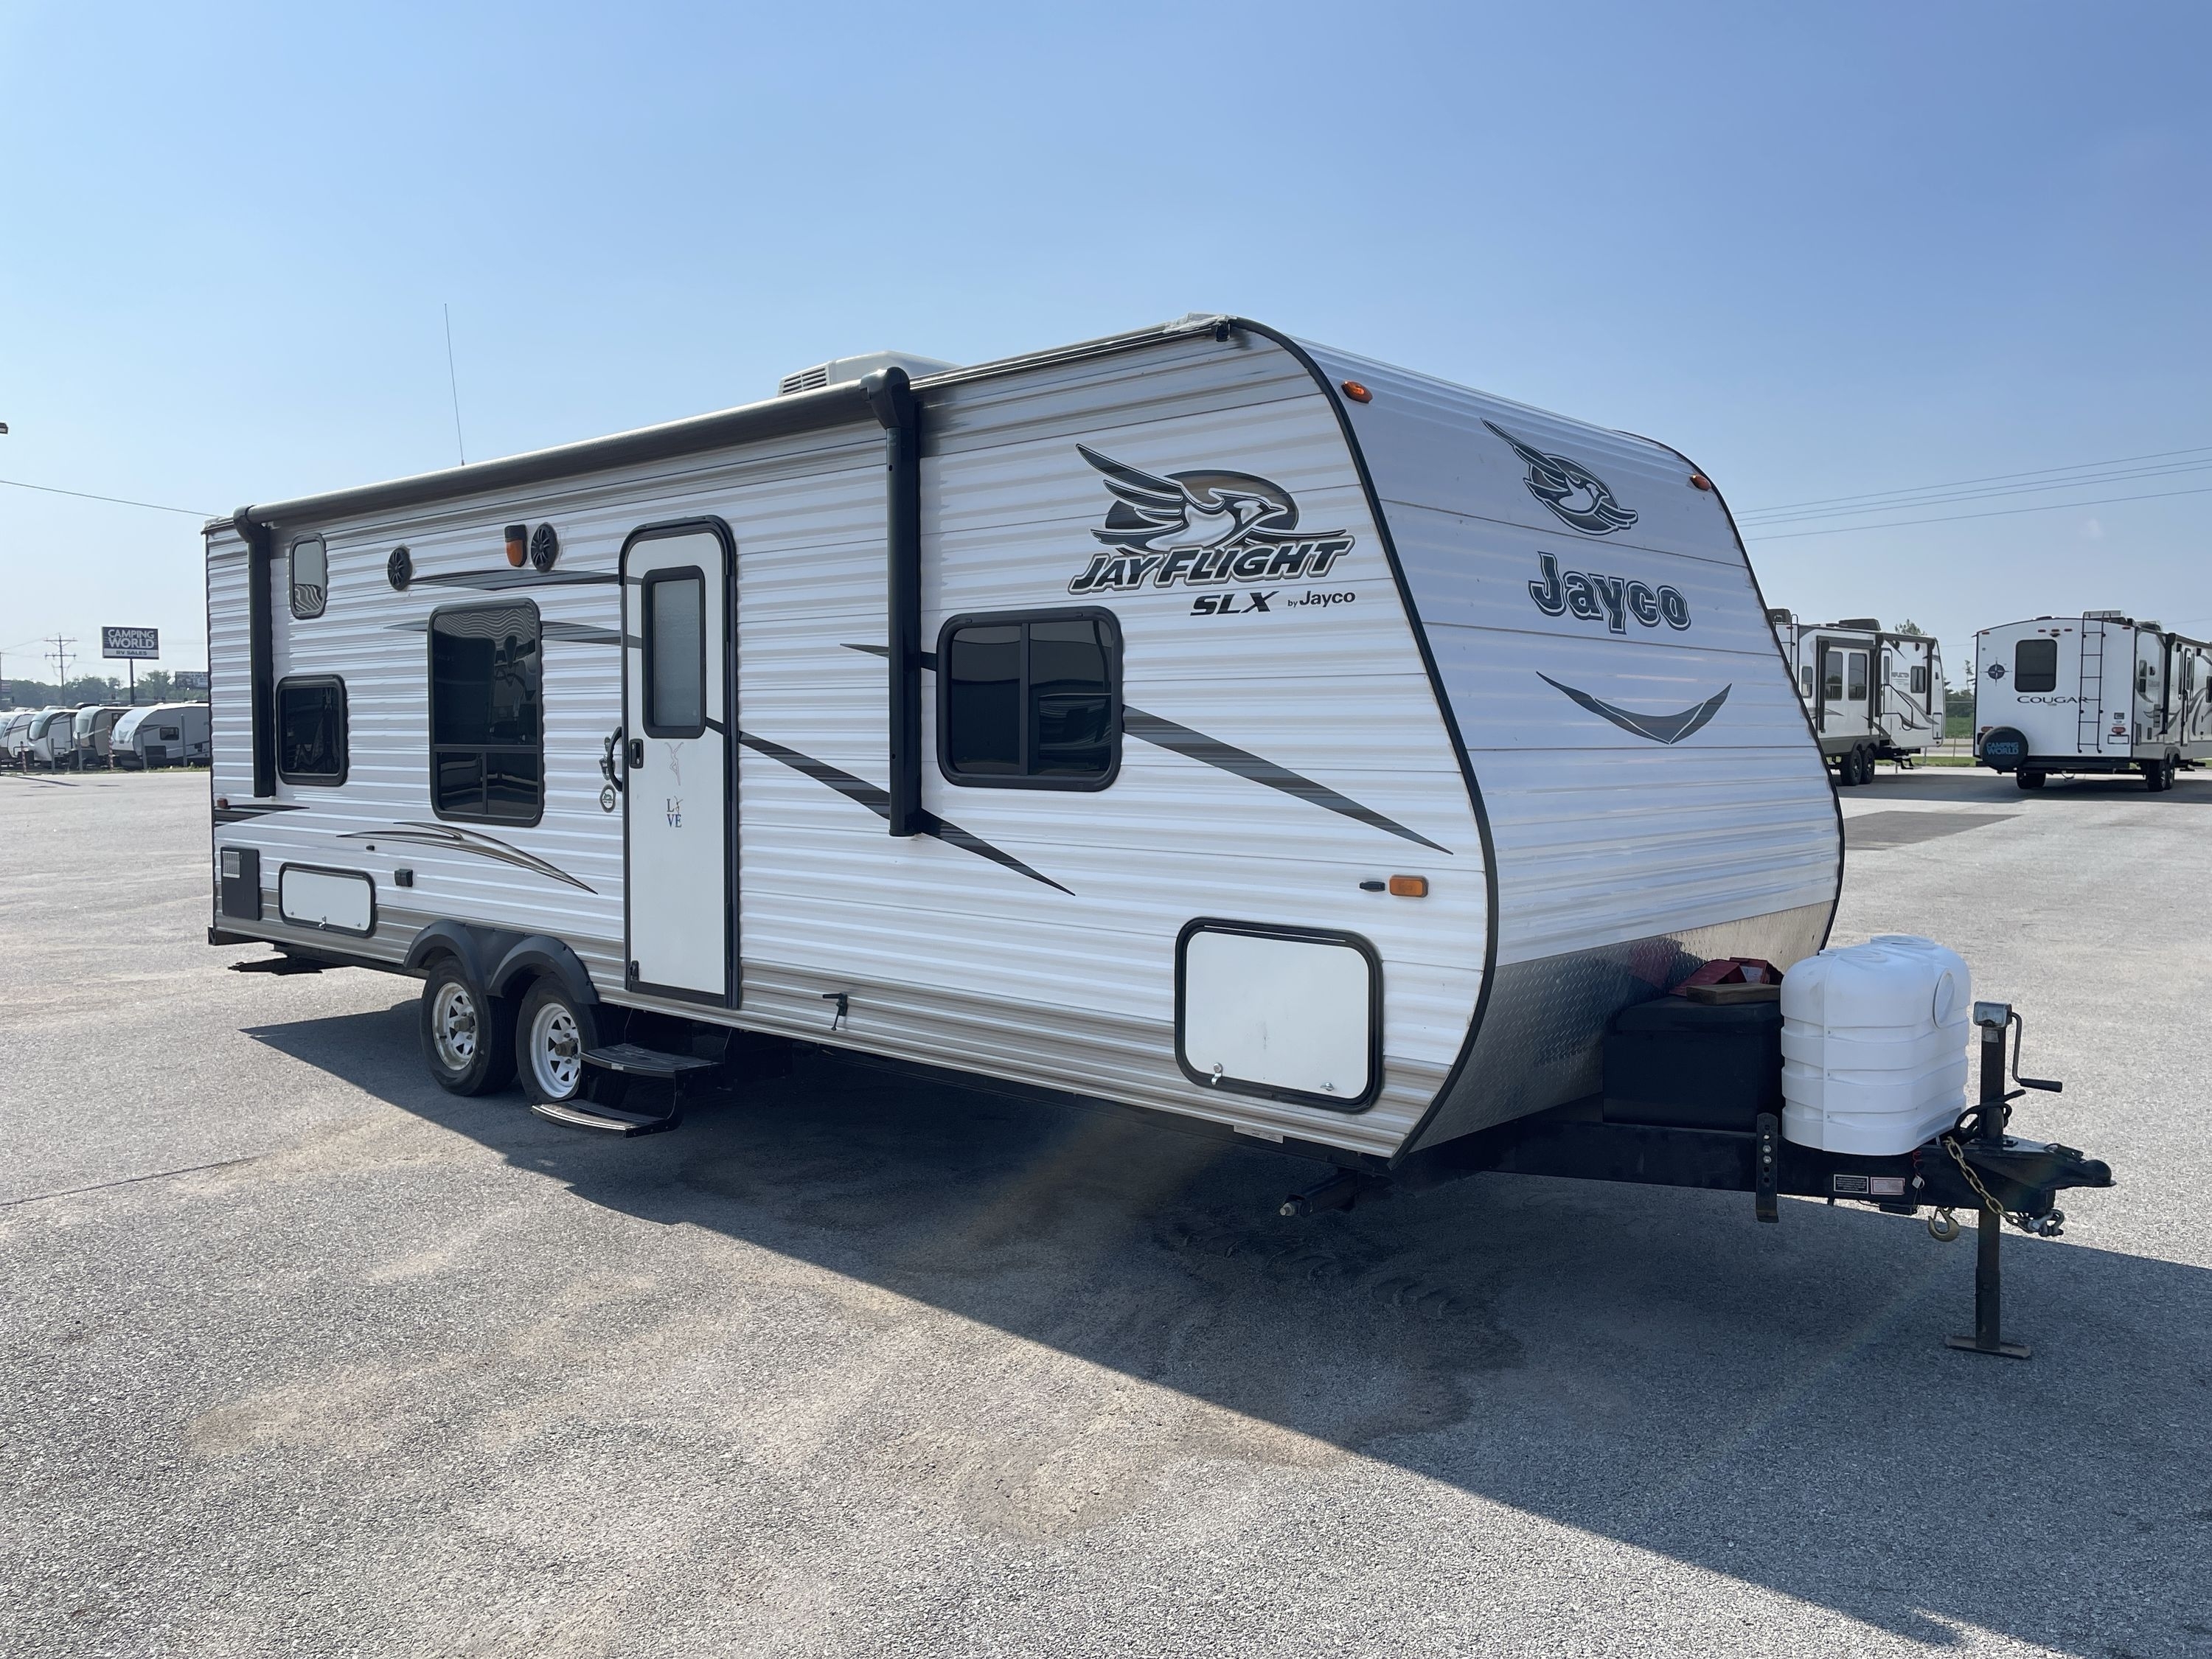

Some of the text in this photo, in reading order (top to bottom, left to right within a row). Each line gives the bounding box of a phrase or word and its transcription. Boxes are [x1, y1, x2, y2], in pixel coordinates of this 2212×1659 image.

[1154, 535, 1355, 588] FLIGHT
[1190, 591, 1355, 616] SLX by Jayco
[1528, 552, 1691, 635] Jayco
[108, 629, 154, 639] CAMPING
[108, 637, 155, 649] WORLD
